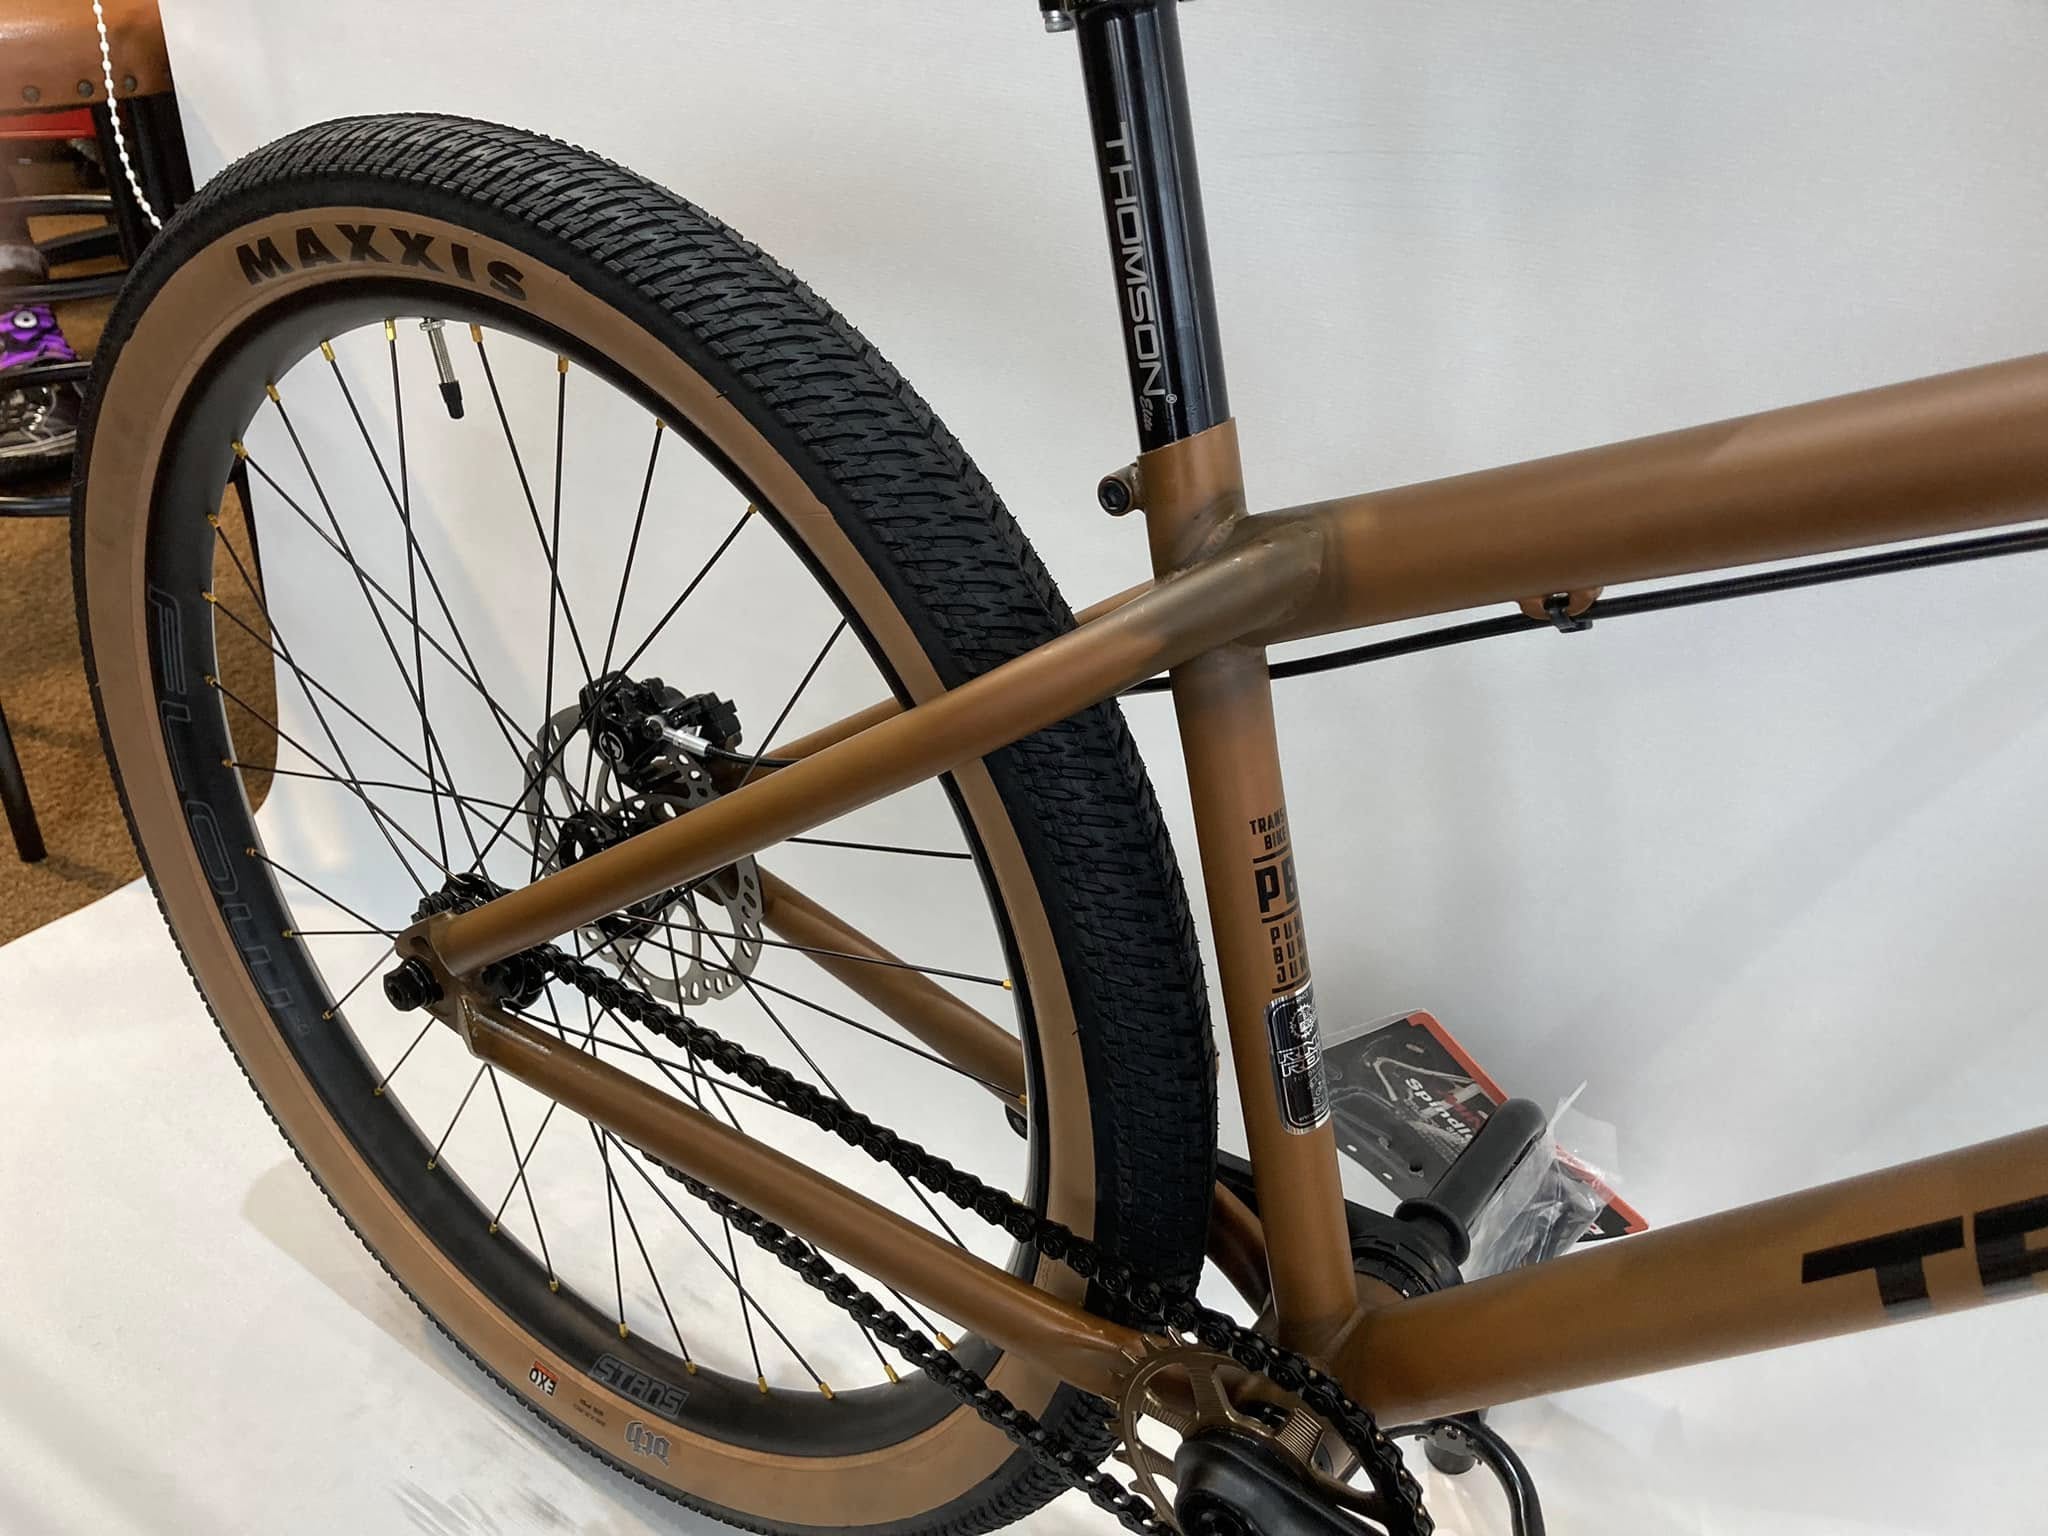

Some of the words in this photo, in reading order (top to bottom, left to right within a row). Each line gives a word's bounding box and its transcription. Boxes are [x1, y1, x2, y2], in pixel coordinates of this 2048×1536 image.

[235, 223, 528, 302] MAXXIS
[1105, 121, 1167, 398] THOMSON
[527, 1366, 558, 1398] EXO
